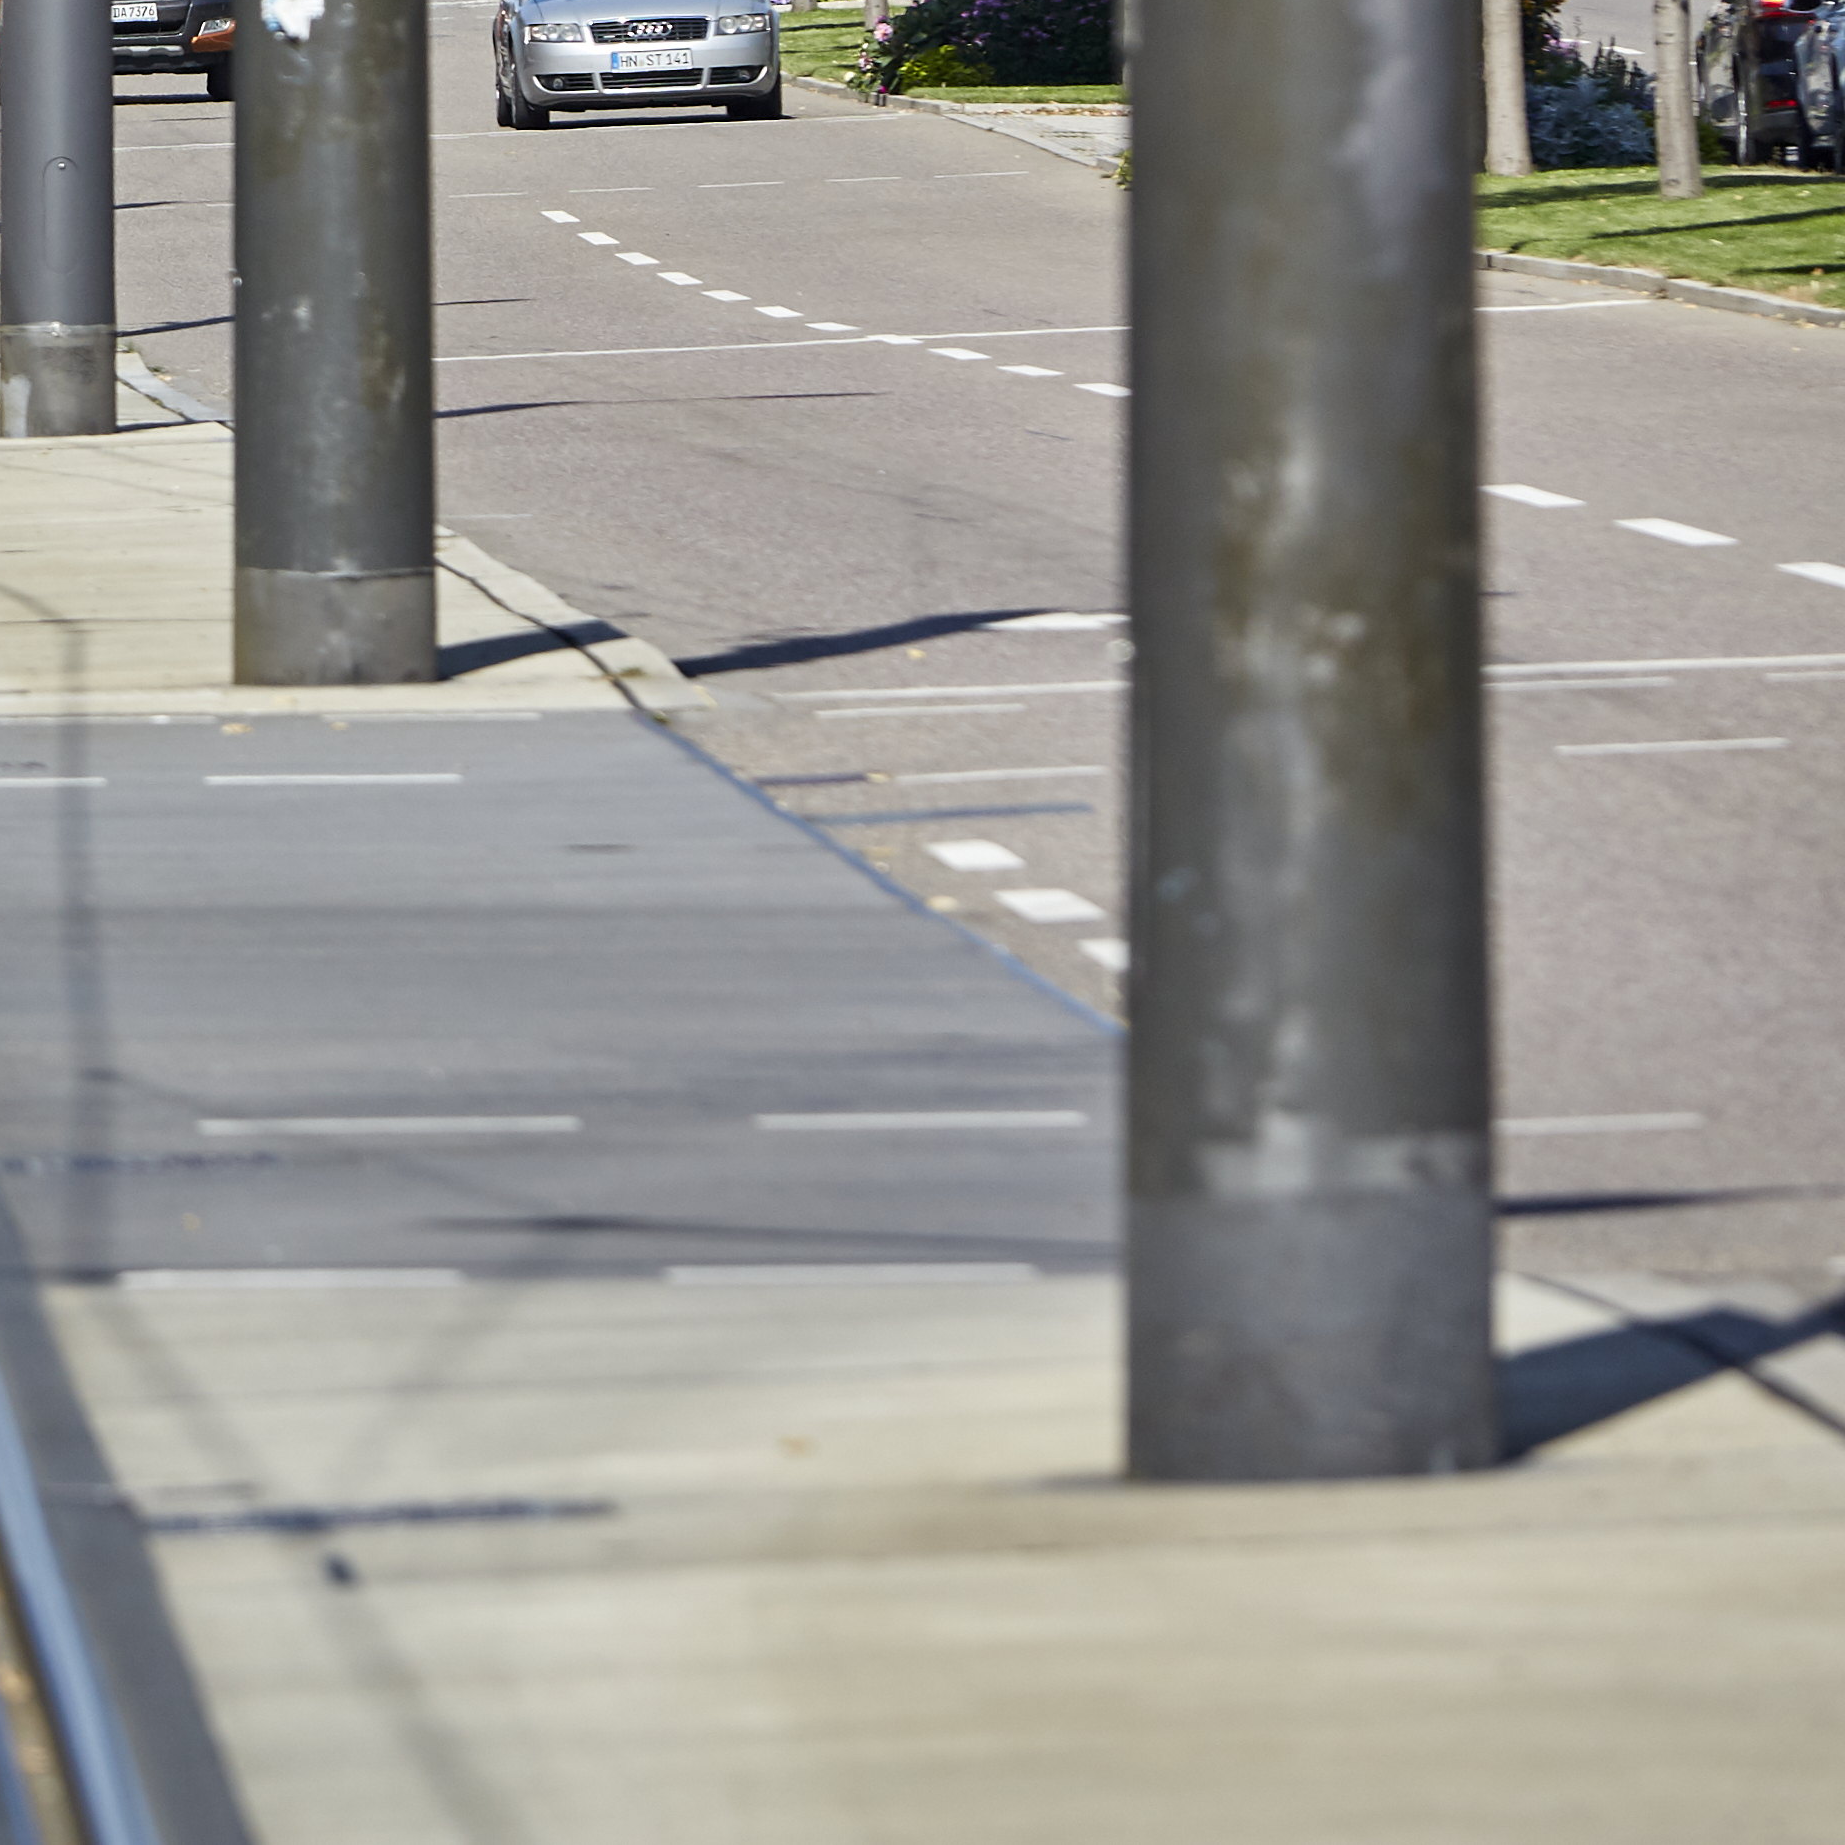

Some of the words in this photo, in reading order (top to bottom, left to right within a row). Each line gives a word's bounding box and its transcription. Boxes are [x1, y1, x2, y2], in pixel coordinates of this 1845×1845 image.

[620, 55, 638, 68] HN
[646, 53, 662, 66] ST
[666, 52, 689, 65] 141
